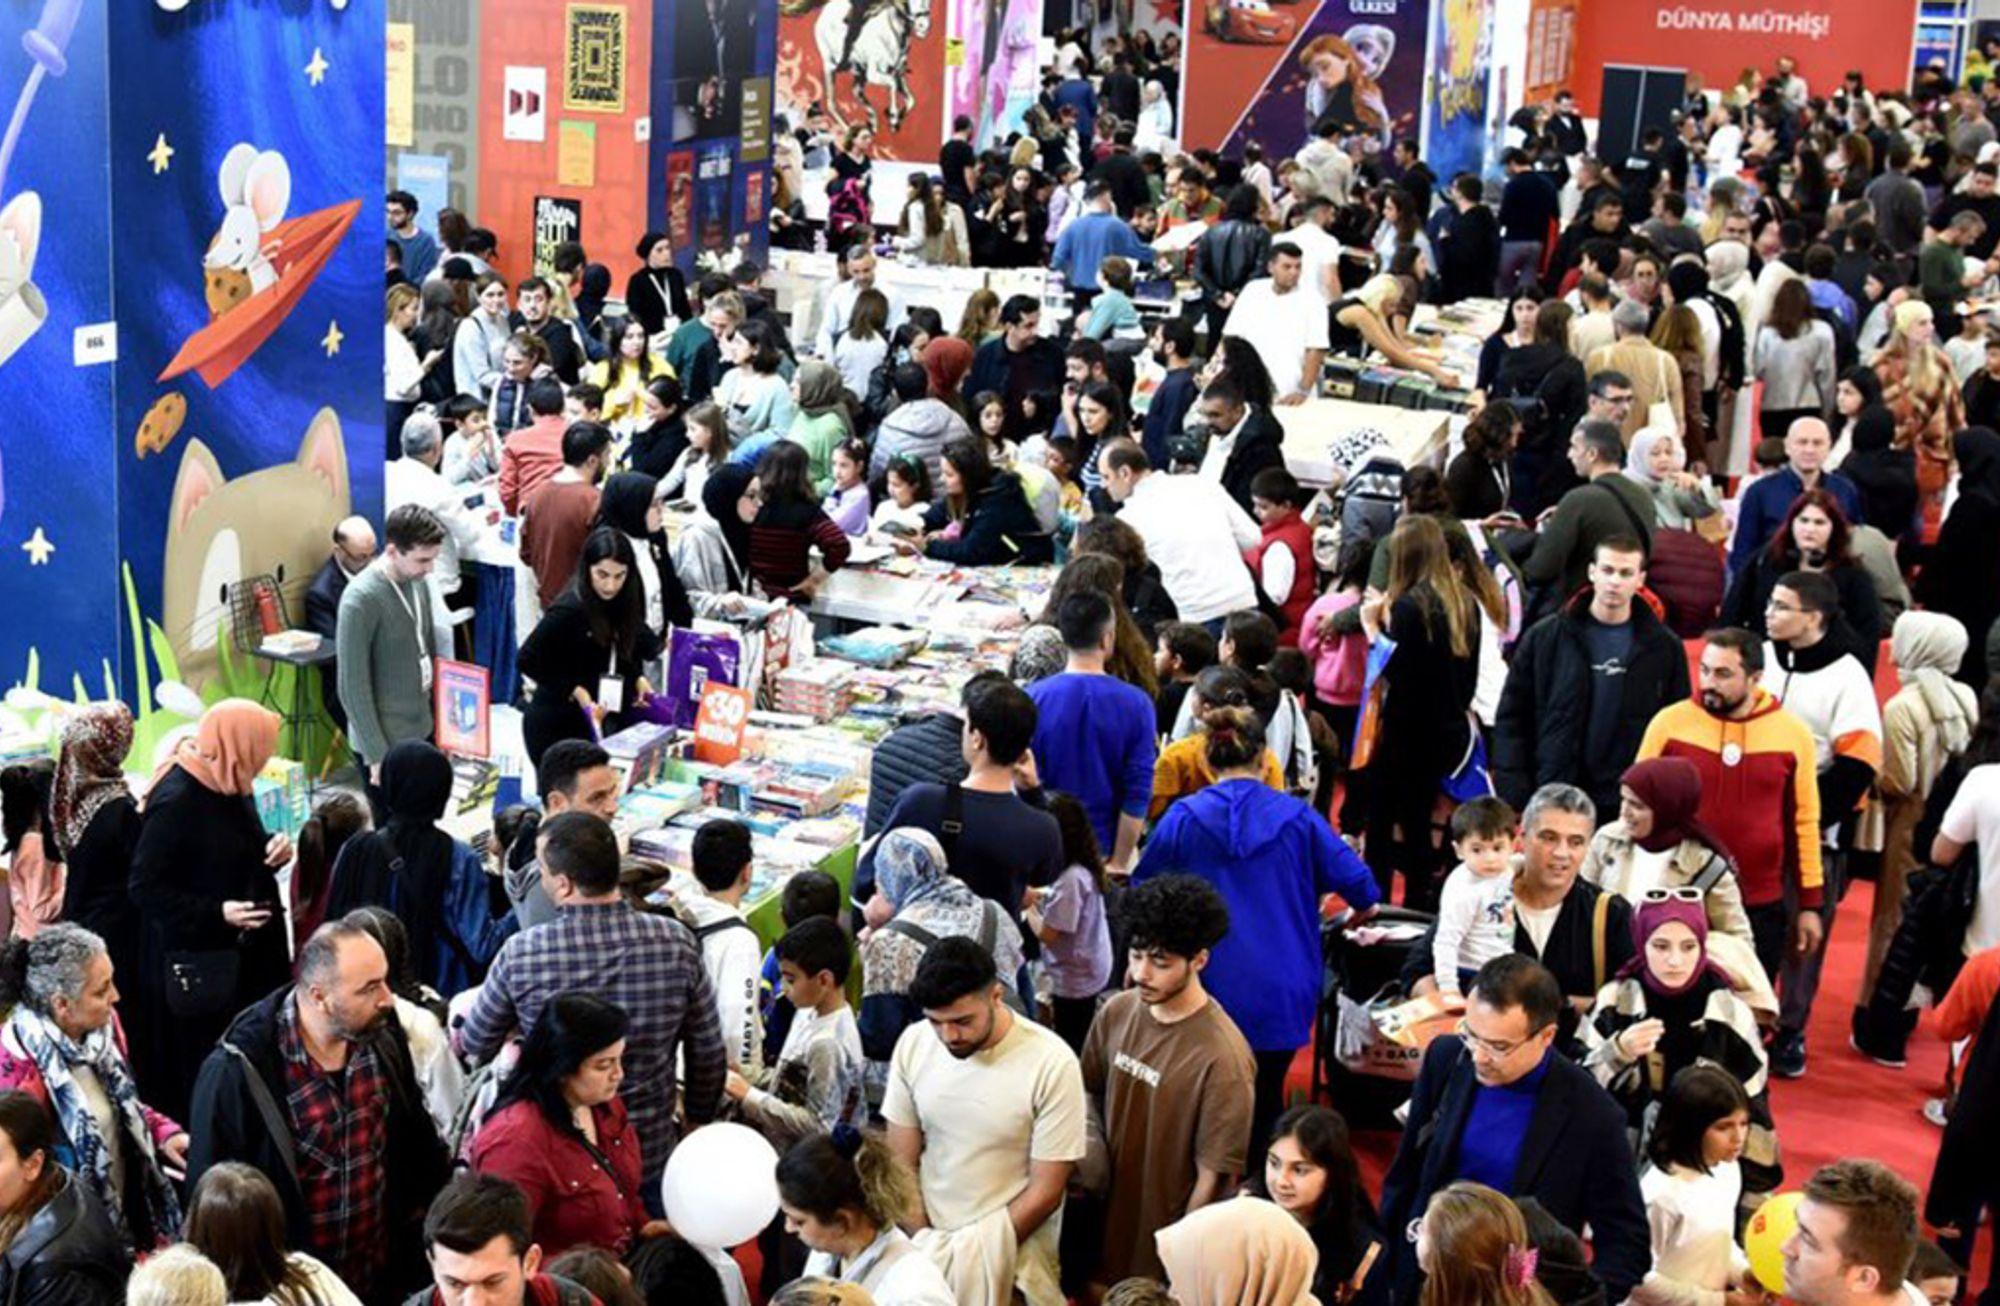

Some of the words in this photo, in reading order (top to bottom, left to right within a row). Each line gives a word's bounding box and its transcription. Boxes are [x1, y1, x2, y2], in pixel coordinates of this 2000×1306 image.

[1656, 7, 1732, 31] DÜNYA
[1738, 9, 1831, 40] MÜTHİŞ!
[1386, 1047, 1420, 1060] BAG
